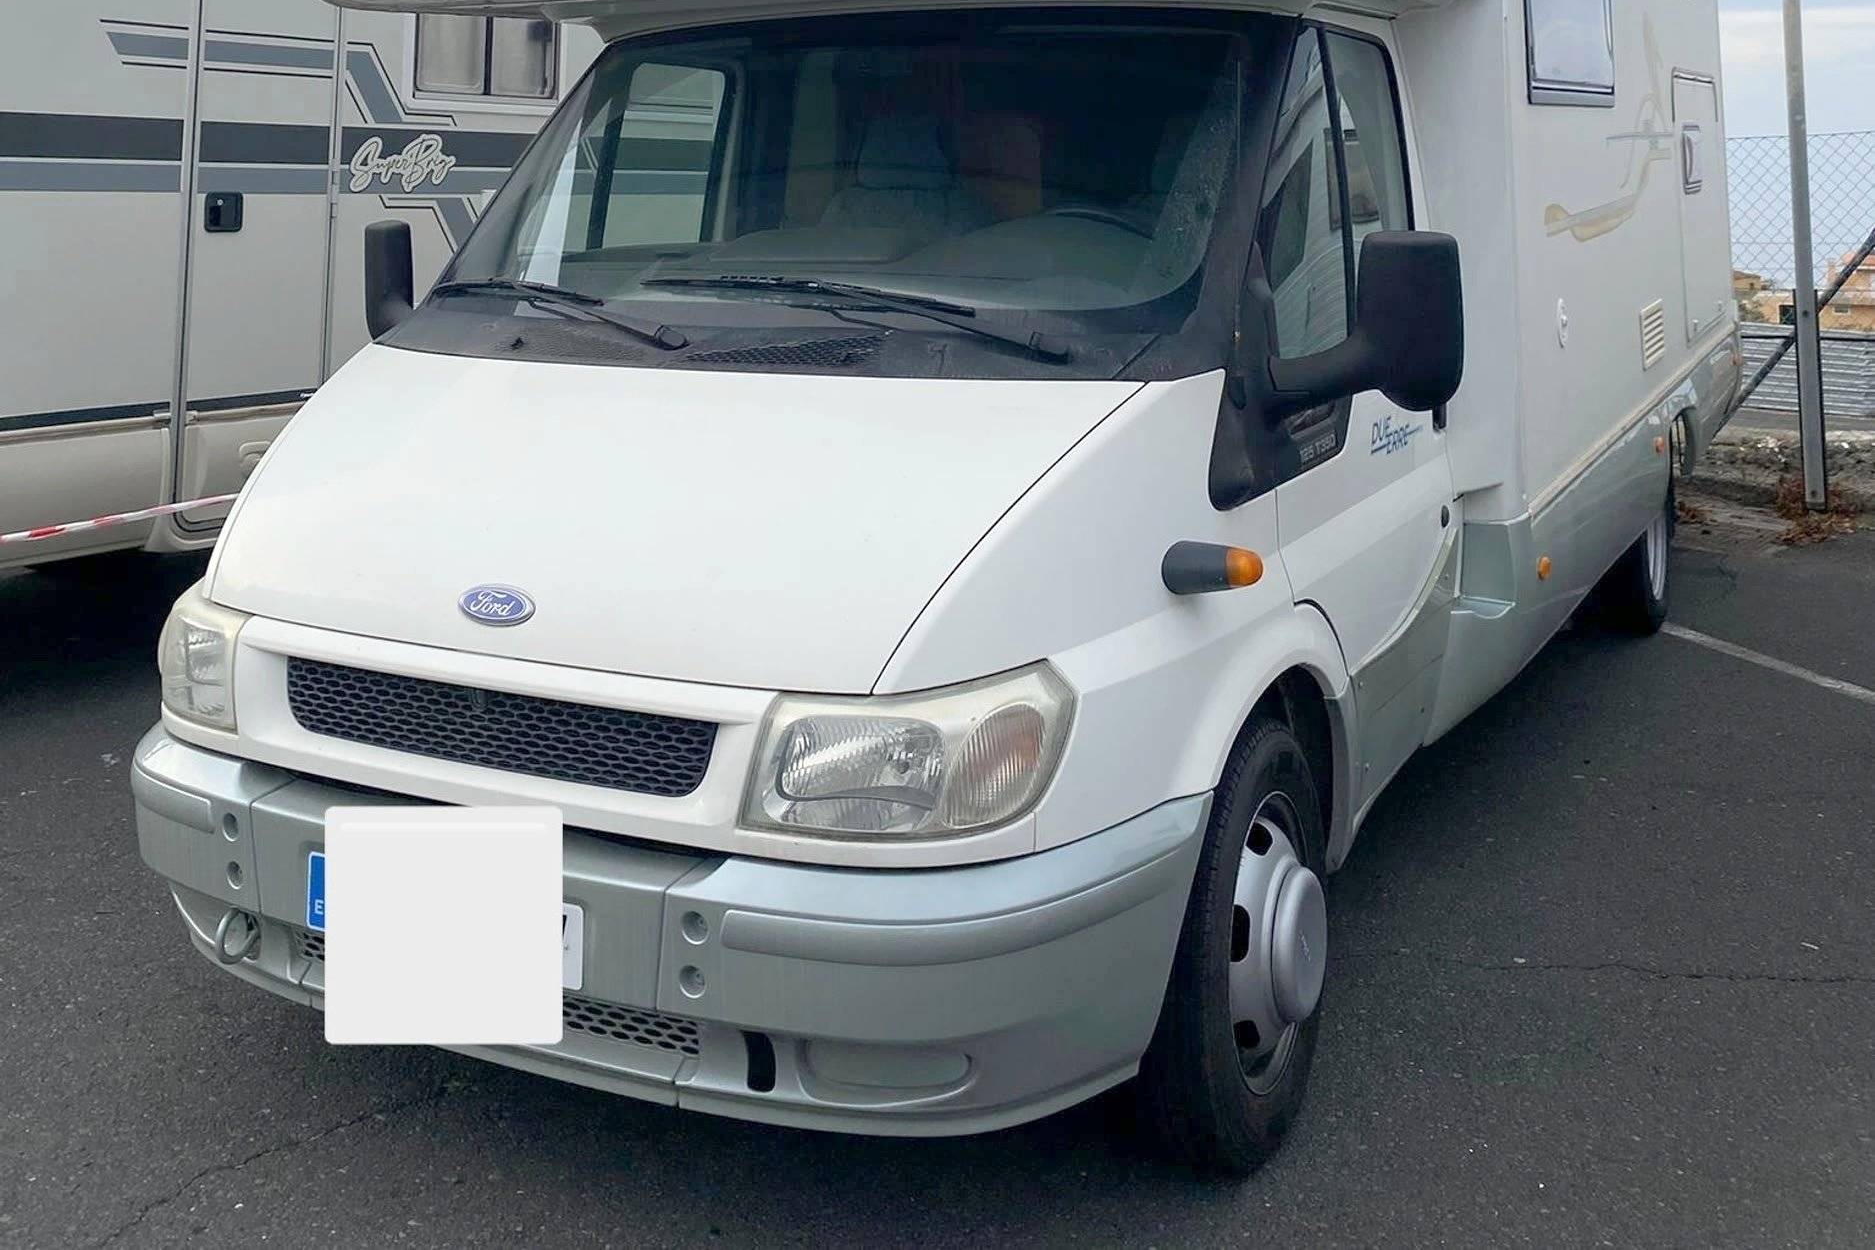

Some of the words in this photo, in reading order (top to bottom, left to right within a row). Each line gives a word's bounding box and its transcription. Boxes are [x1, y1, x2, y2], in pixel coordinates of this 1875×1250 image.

[1371, 415, 1393, 445] DUE
[1386, 424, 1410, 455] ERRE
[469, 590, 516, 616] Ford
[314, 899, 324, 915] E
